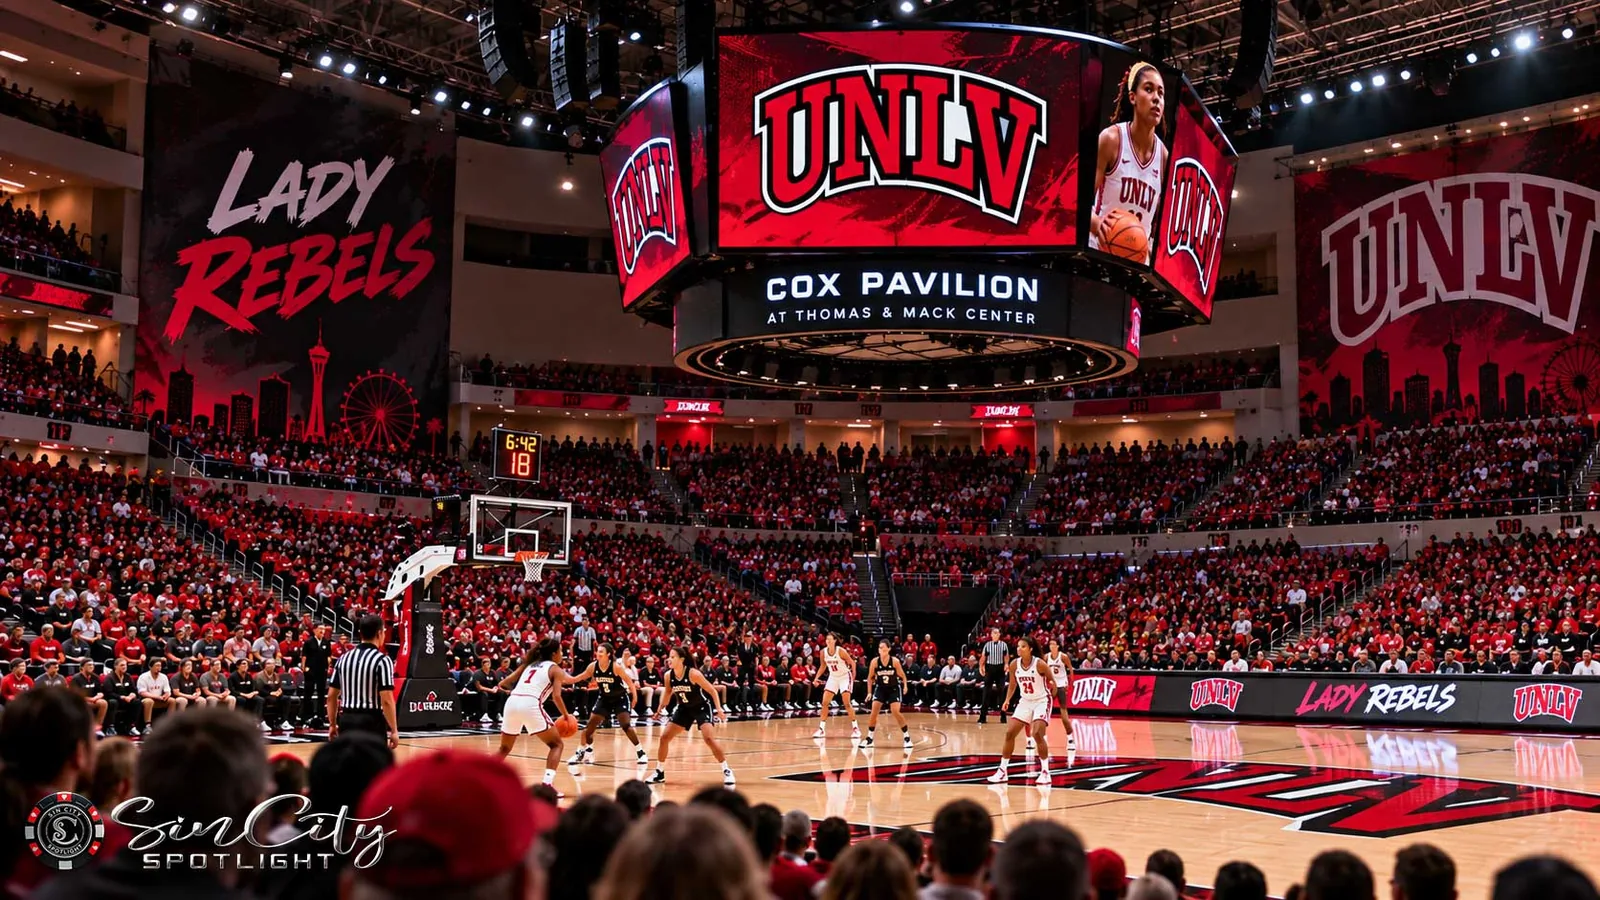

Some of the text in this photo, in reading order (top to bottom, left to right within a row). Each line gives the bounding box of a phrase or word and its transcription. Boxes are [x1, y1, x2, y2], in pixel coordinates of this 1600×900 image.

[754, 63, 1048, 225] UNLV
[206, 147, 396, 236] LADY
[612, 137, 677, 275] UNLV
[1119, 176, 1157, 213] UNLV
[1167, 157, 1224, 295] UNLV
[1321, 172, 1600, 346] UNLV
[163, 215, 436, 345] REBELS
[766, 271, 1039, 302] COX PAVILION
[766, 306, 1036, 325] AT THOMAS & MACK CENTER
[505, 433, 537, 453] 6:42
[511, 452, 531, 476] 18
[1071, 676, 1117, 707] UNLV
[1189, 677, 1244, 712] UNLV
[1295, 680, 1457, 717] LADY REBELS
[1513, 683, 1582, 724] UNLV
